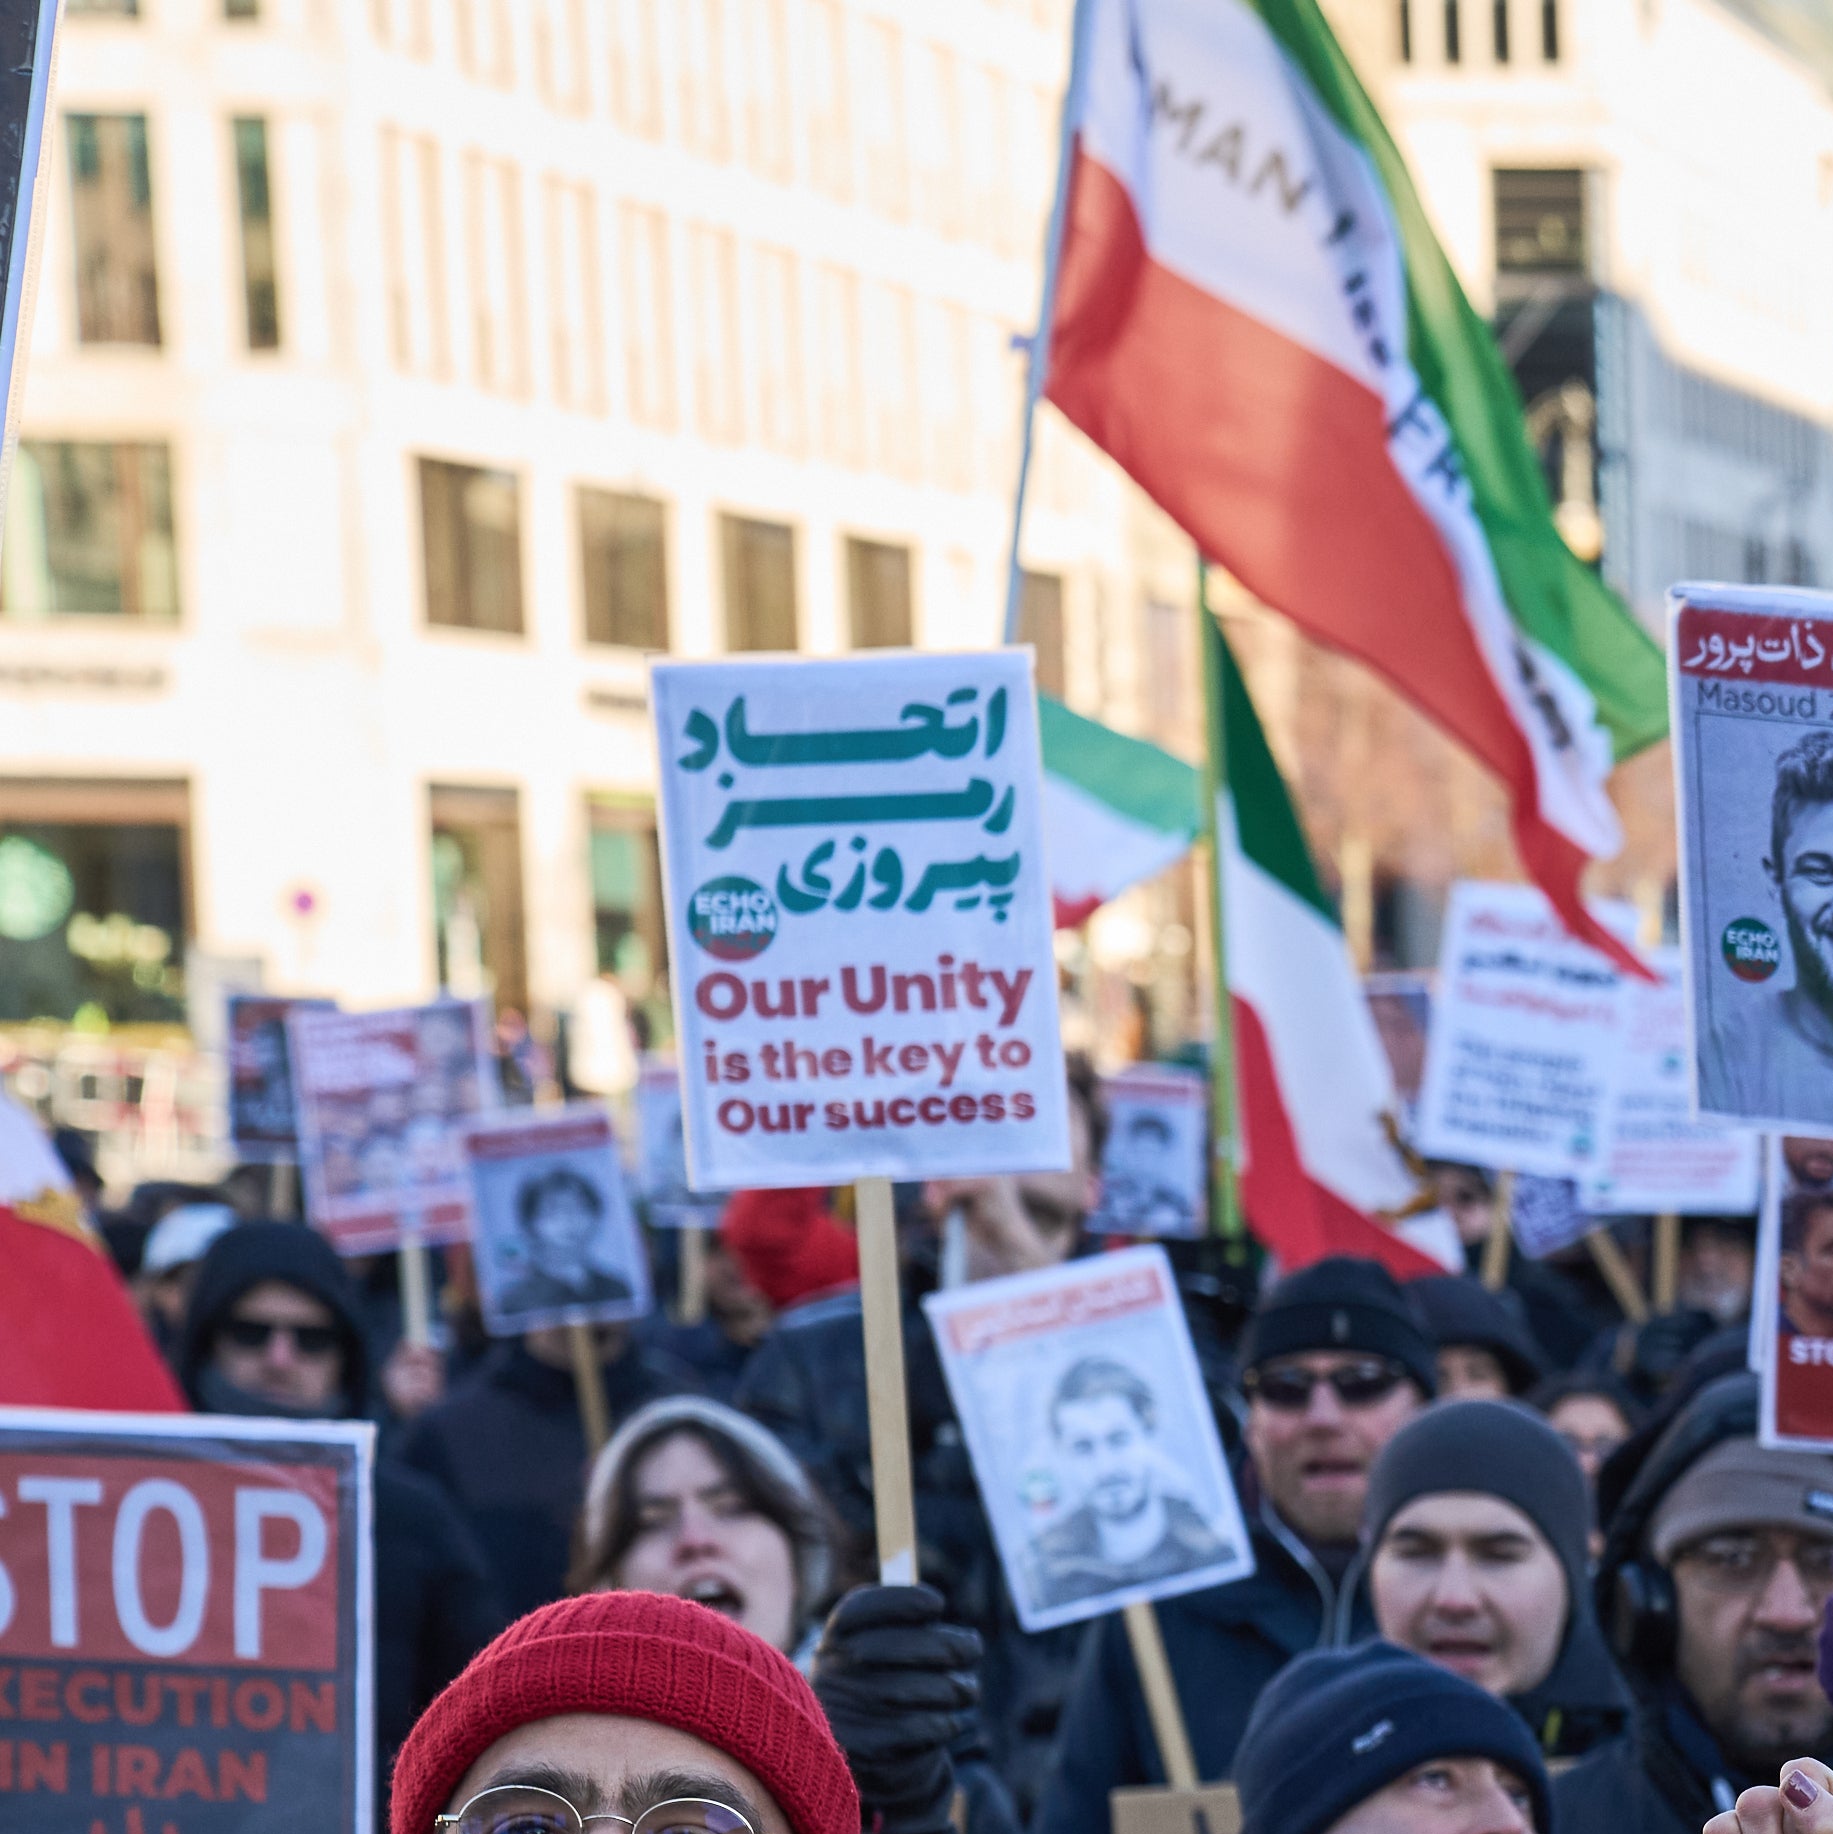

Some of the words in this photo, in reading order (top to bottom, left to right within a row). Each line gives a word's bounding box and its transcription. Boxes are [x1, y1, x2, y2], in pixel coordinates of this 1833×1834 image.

[1697, 680, 1817, 719] Masoud
[677, 685, 1007, 772] اتحاد
[705, 772, 1016, 850] رمز
[695, 891, 771, 915] ECHO
[776, 835, 1021, 922] پیروزی
[709, 914, 776, 935] IRAN
[1727, 929, 1774, 949] ECHO
[1736, 945, 1779, 962] IRAN
[696, 971, 829, 1020] Our
[841, 953, 1033, 1028] Unity
[705, 1040, 750, 1083] is
[760, 1038, 852, 1080] the
[862, 1036, 966, 1087] key
[976, 1033, 1032, 1069] to
[718, 1098, 814, 1135] Our
[824, 1091, 1036, 1131] success
[0, 1474, 328, 1661] TOP
[0, 1667, 335, 1732] ECUTION
[92, 1744, 267, 1803] IRAN
